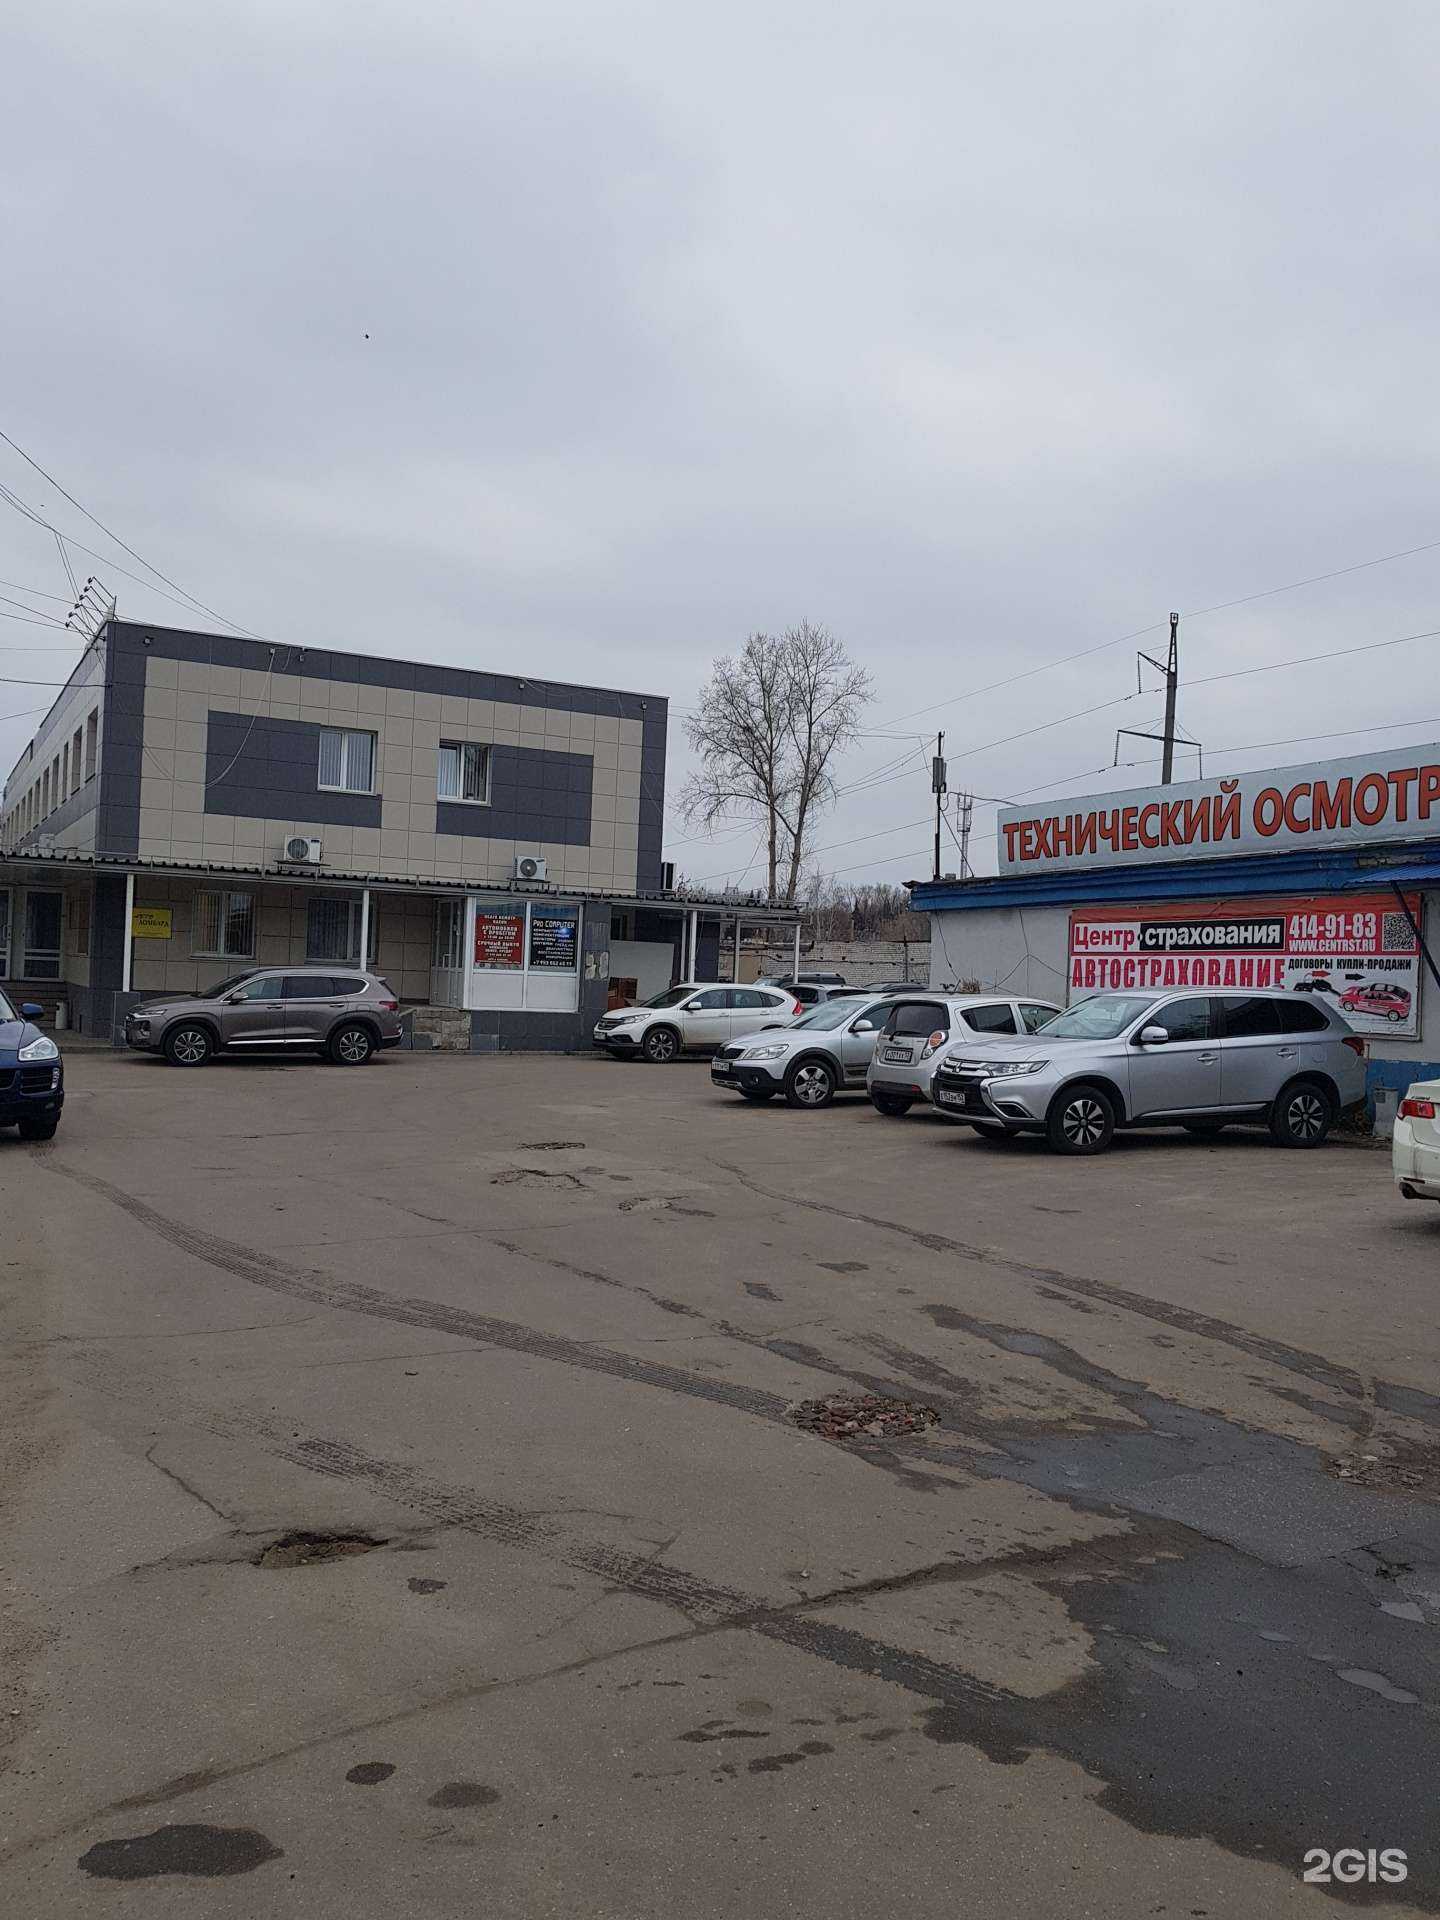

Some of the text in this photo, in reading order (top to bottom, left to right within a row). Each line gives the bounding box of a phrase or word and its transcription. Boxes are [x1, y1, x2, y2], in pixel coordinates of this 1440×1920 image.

[1003, 765, 1440, 862] ТЕХНИЧЕСКИЙ ОСМОТР
[1074, 924, 1280, 951] Центр страхования
[1289, 913, 1377, 939] 414-91-83
[1288, 938, 1377, 952] WWW.CENTRST.RU
[1072, 958, 1286, 989] АВТОСТРАХОВАНИЕ
[1288, 958, 1412, 971] ДОГОВОРЫ КУПЛИ-ПРОДАЖИ
